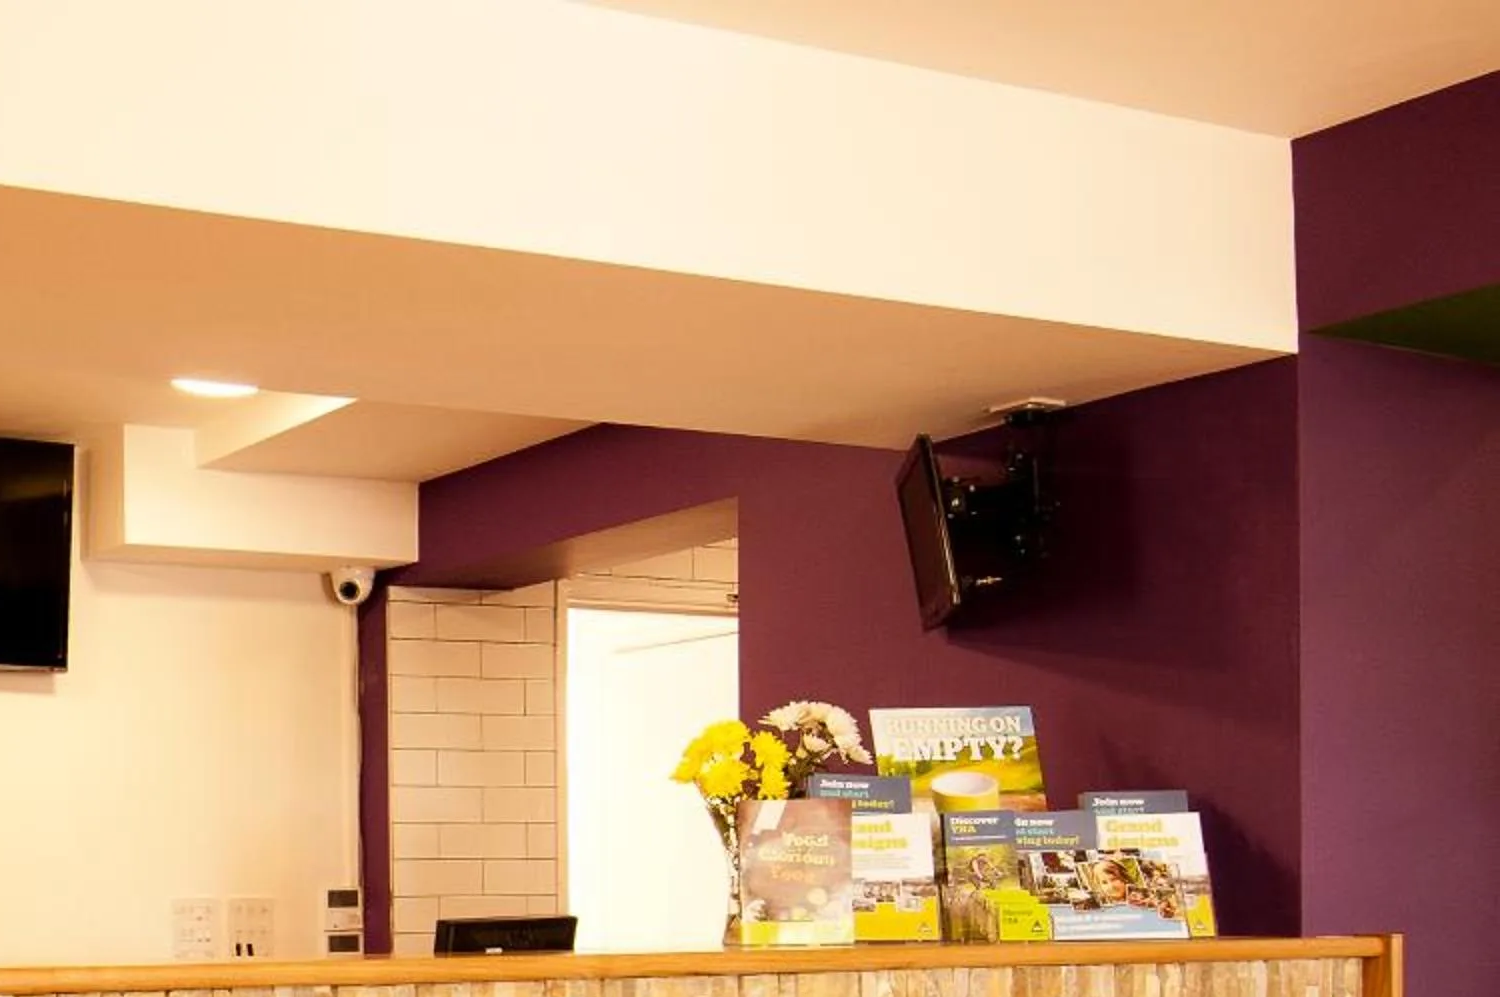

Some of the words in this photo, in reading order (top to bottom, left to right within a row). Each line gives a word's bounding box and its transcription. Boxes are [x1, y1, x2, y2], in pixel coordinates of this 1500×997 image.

[887, 716, 988, 735] RUNNING
[990, 715, 1021, 733] ON
[894, 736, 1024, 762] EMPTY?
